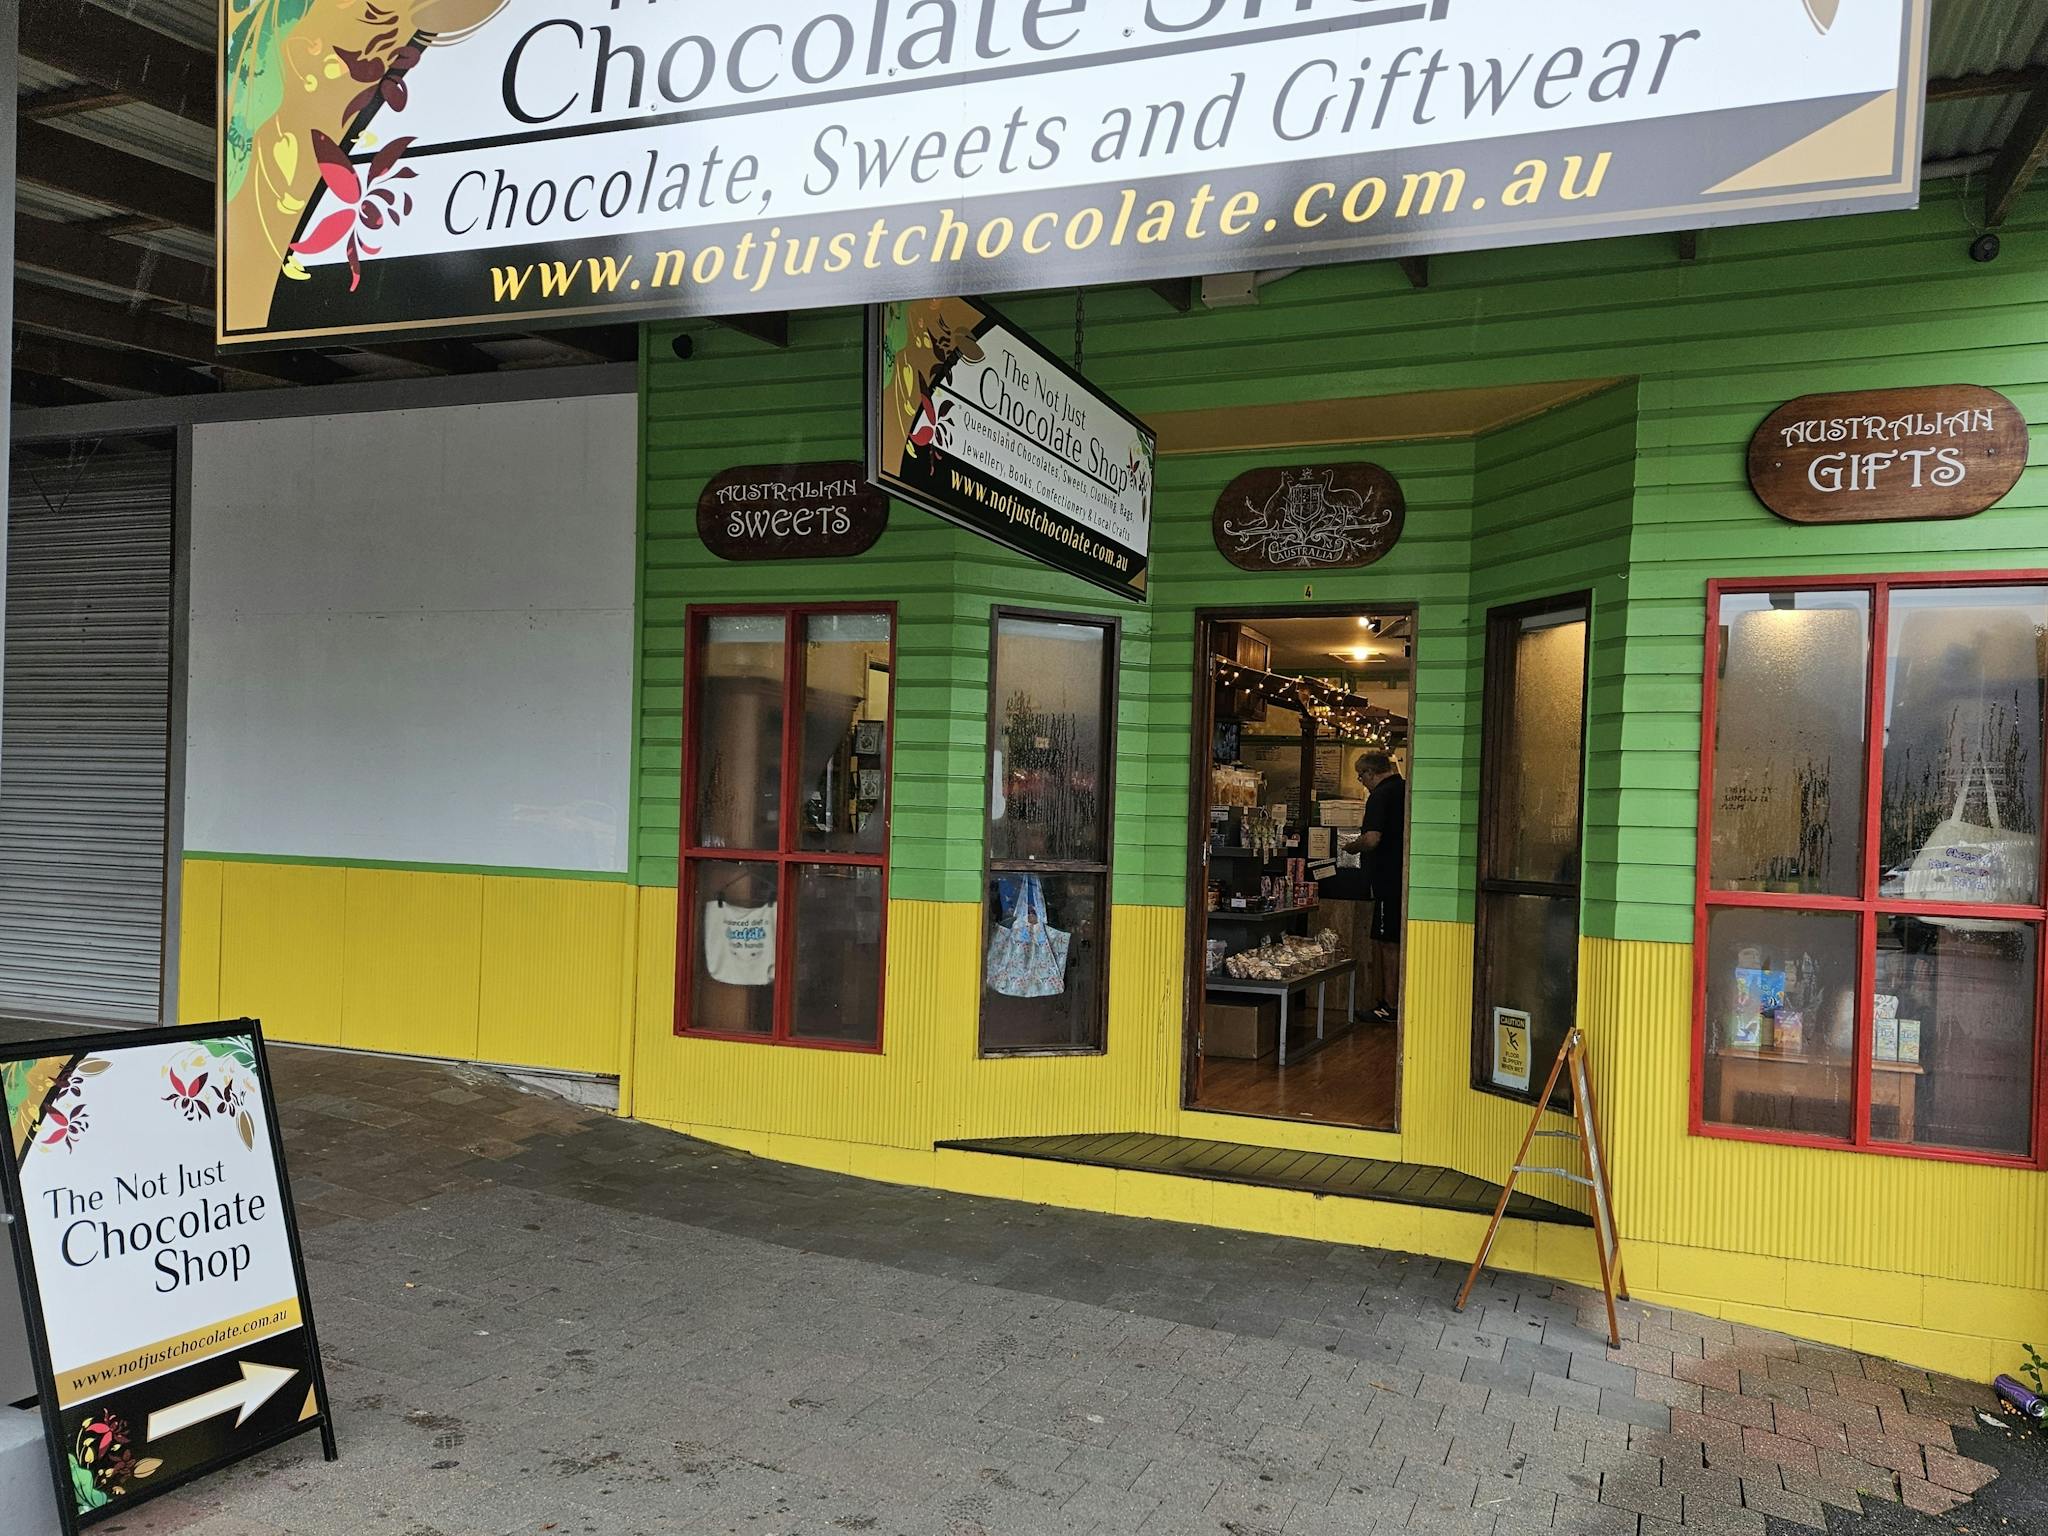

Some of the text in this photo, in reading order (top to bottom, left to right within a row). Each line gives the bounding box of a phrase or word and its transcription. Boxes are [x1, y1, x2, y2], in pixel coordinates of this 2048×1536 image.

[501, 0, 1081, 124] Chocolate
[444, 28, 1701, 236] Chocolate, Sweets and Giftwear
[490, 151, 1613, 302] www.notjustchocolate.com.au
[1002, 349, 1087, 431] The Not Just
[963, 411, 1016, 453] Queensland
[979, 366, 1128, 497] Chocolate Shop
[1780, 408, 1995, 448] AUSTRALIAN
[716, 479, 857, 504] AUSTRALIAN
[962, 440, 1131, 542] Jewellery, Books, Confectionery & Local Crafts
[1807, 446, 1967, 493] GIFTS
[727, 505, 851, 539] SWEETS
[951, 469, 1129, 572] www.notjustchocolate.com.au
[1277, 546, 1335, 561] AUSTRALIA
[1304, 585, 1312, 599] 4
[1500, 1016, 1526, 1029] CAUTION
[43, 1159, 227, 1220] The Not Just
[61, 1190, 267, 1268] Chocolate
[154, 1241, 252, 1294] Shop
[72, 1308, 289, 1392] www.notjustchocolate.com.au
